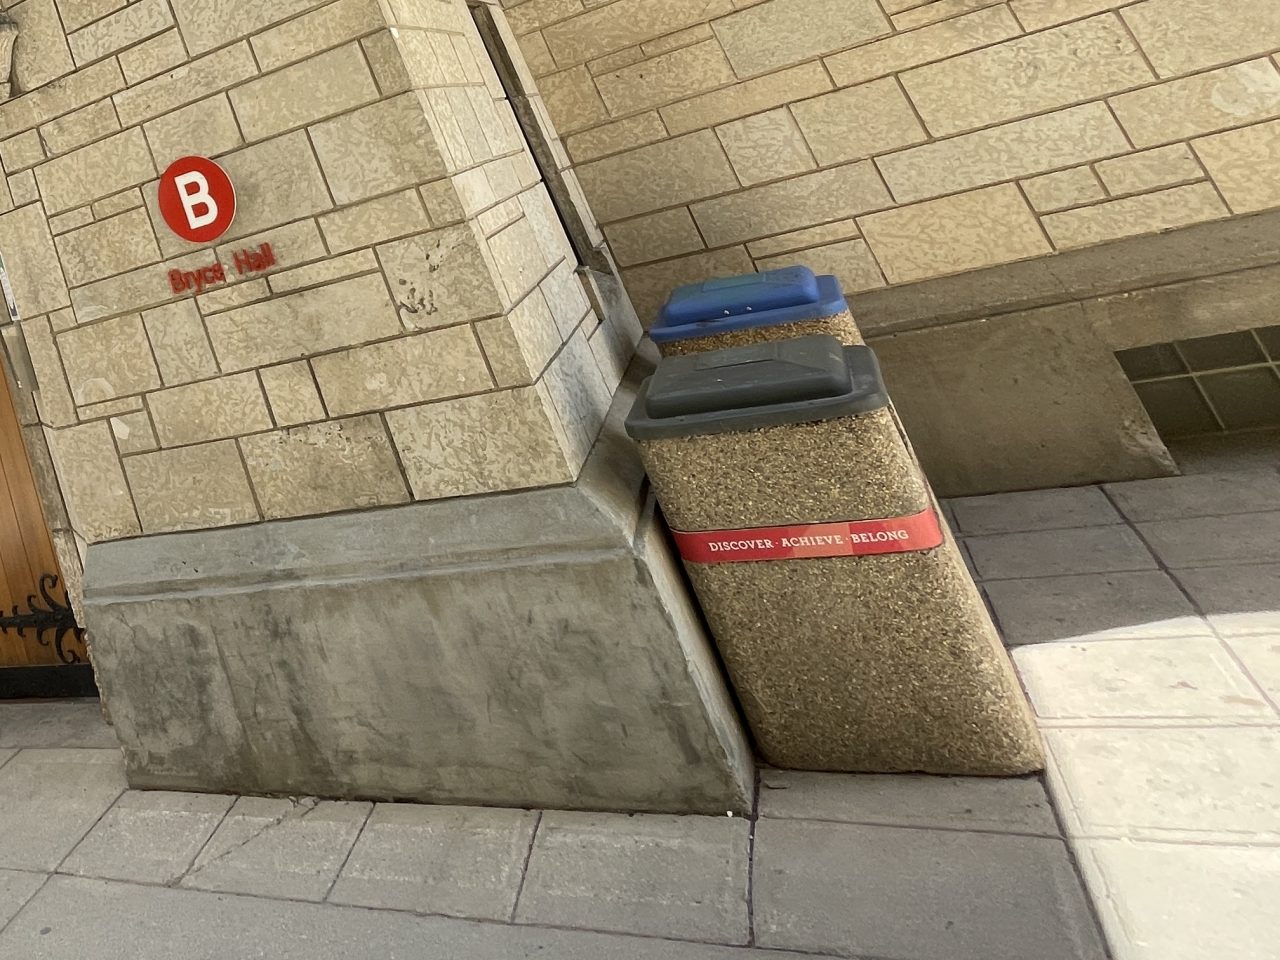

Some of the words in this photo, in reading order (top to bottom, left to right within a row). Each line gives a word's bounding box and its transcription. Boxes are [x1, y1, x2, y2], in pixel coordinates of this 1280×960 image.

[174, 170, 218, 230] B
[168, 262, 226, 295] Bryce
[232, 242, 276, 275] Hall
[708, 539, 774, 552] DISCOVER
[782, 535, 844, 548] ACHIEVE
[851, 529, 909, 544] BELONG
